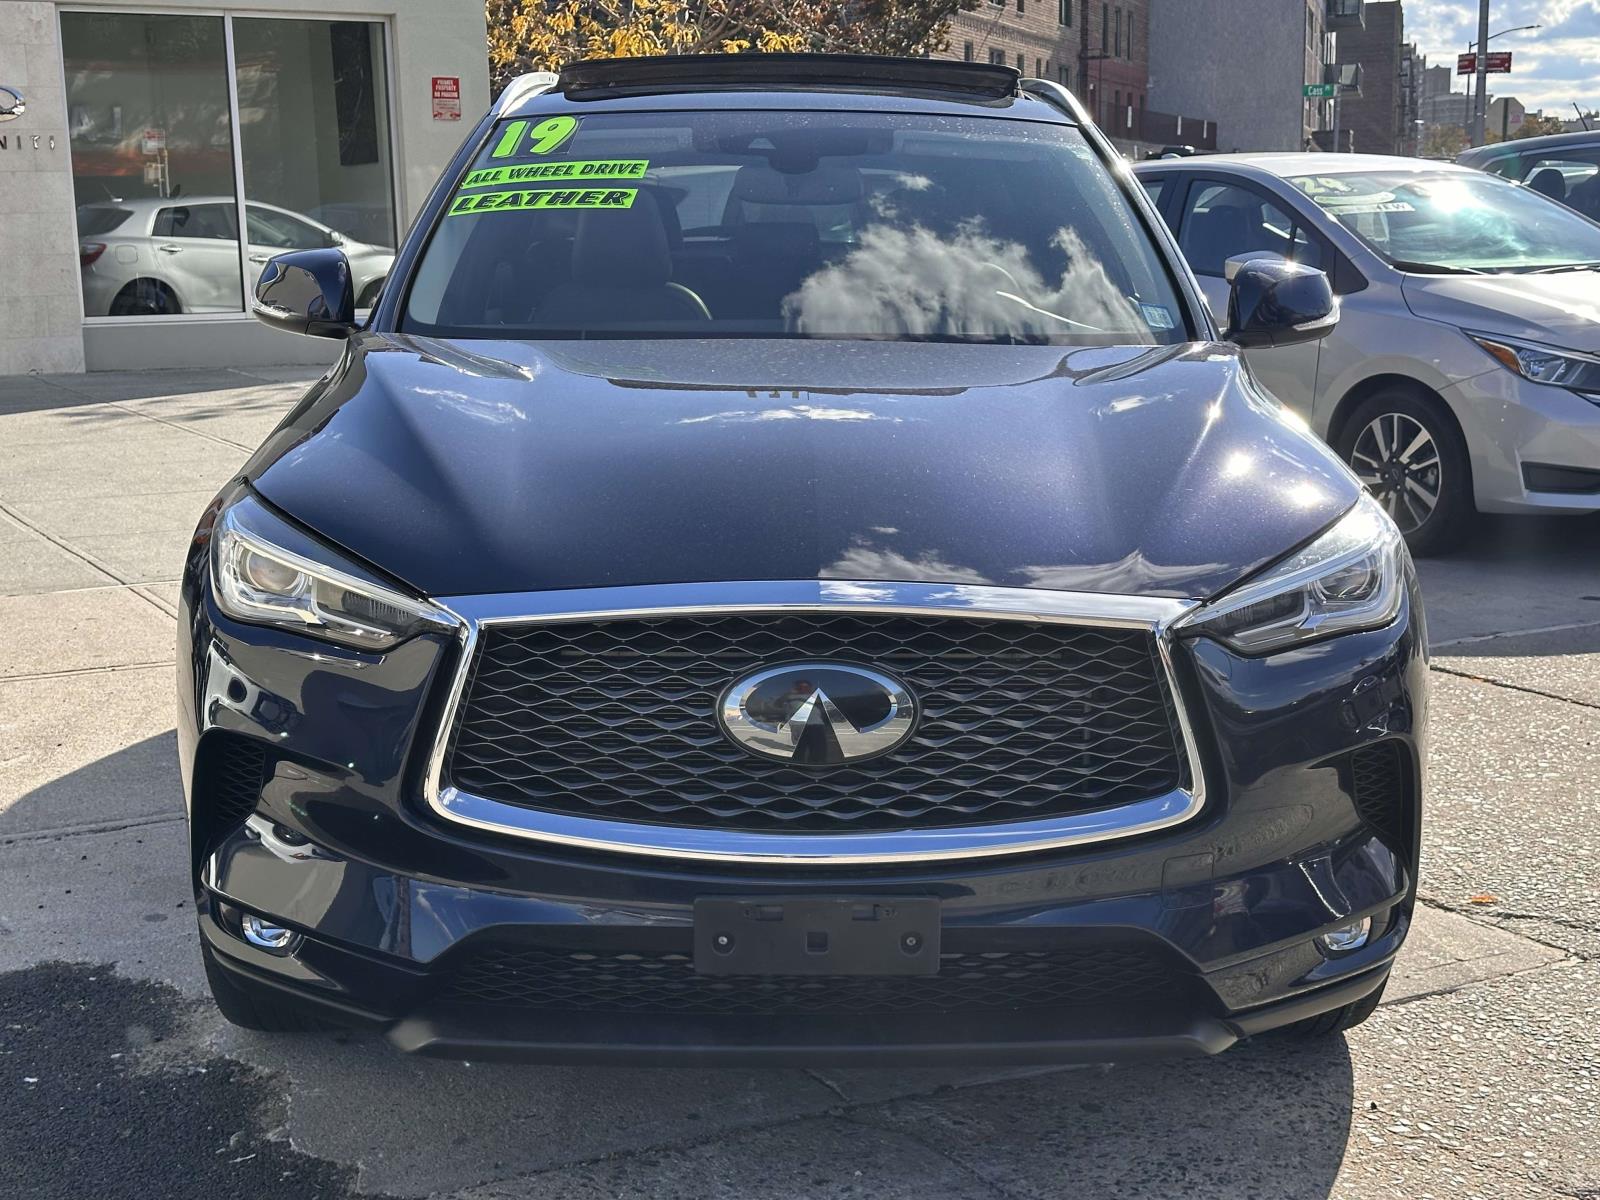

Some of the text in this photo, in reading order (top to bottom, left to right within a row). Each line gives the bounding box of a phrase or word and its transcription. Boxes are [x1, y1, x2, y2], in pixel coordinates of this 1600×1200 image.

[1308, 86, 1323, 96] Cass
[492, 116, 579, 158] 19
[466, 162, 645, 186] ALL WHEEL DRIVE
[452, 190, 633, 213] LEATHER
